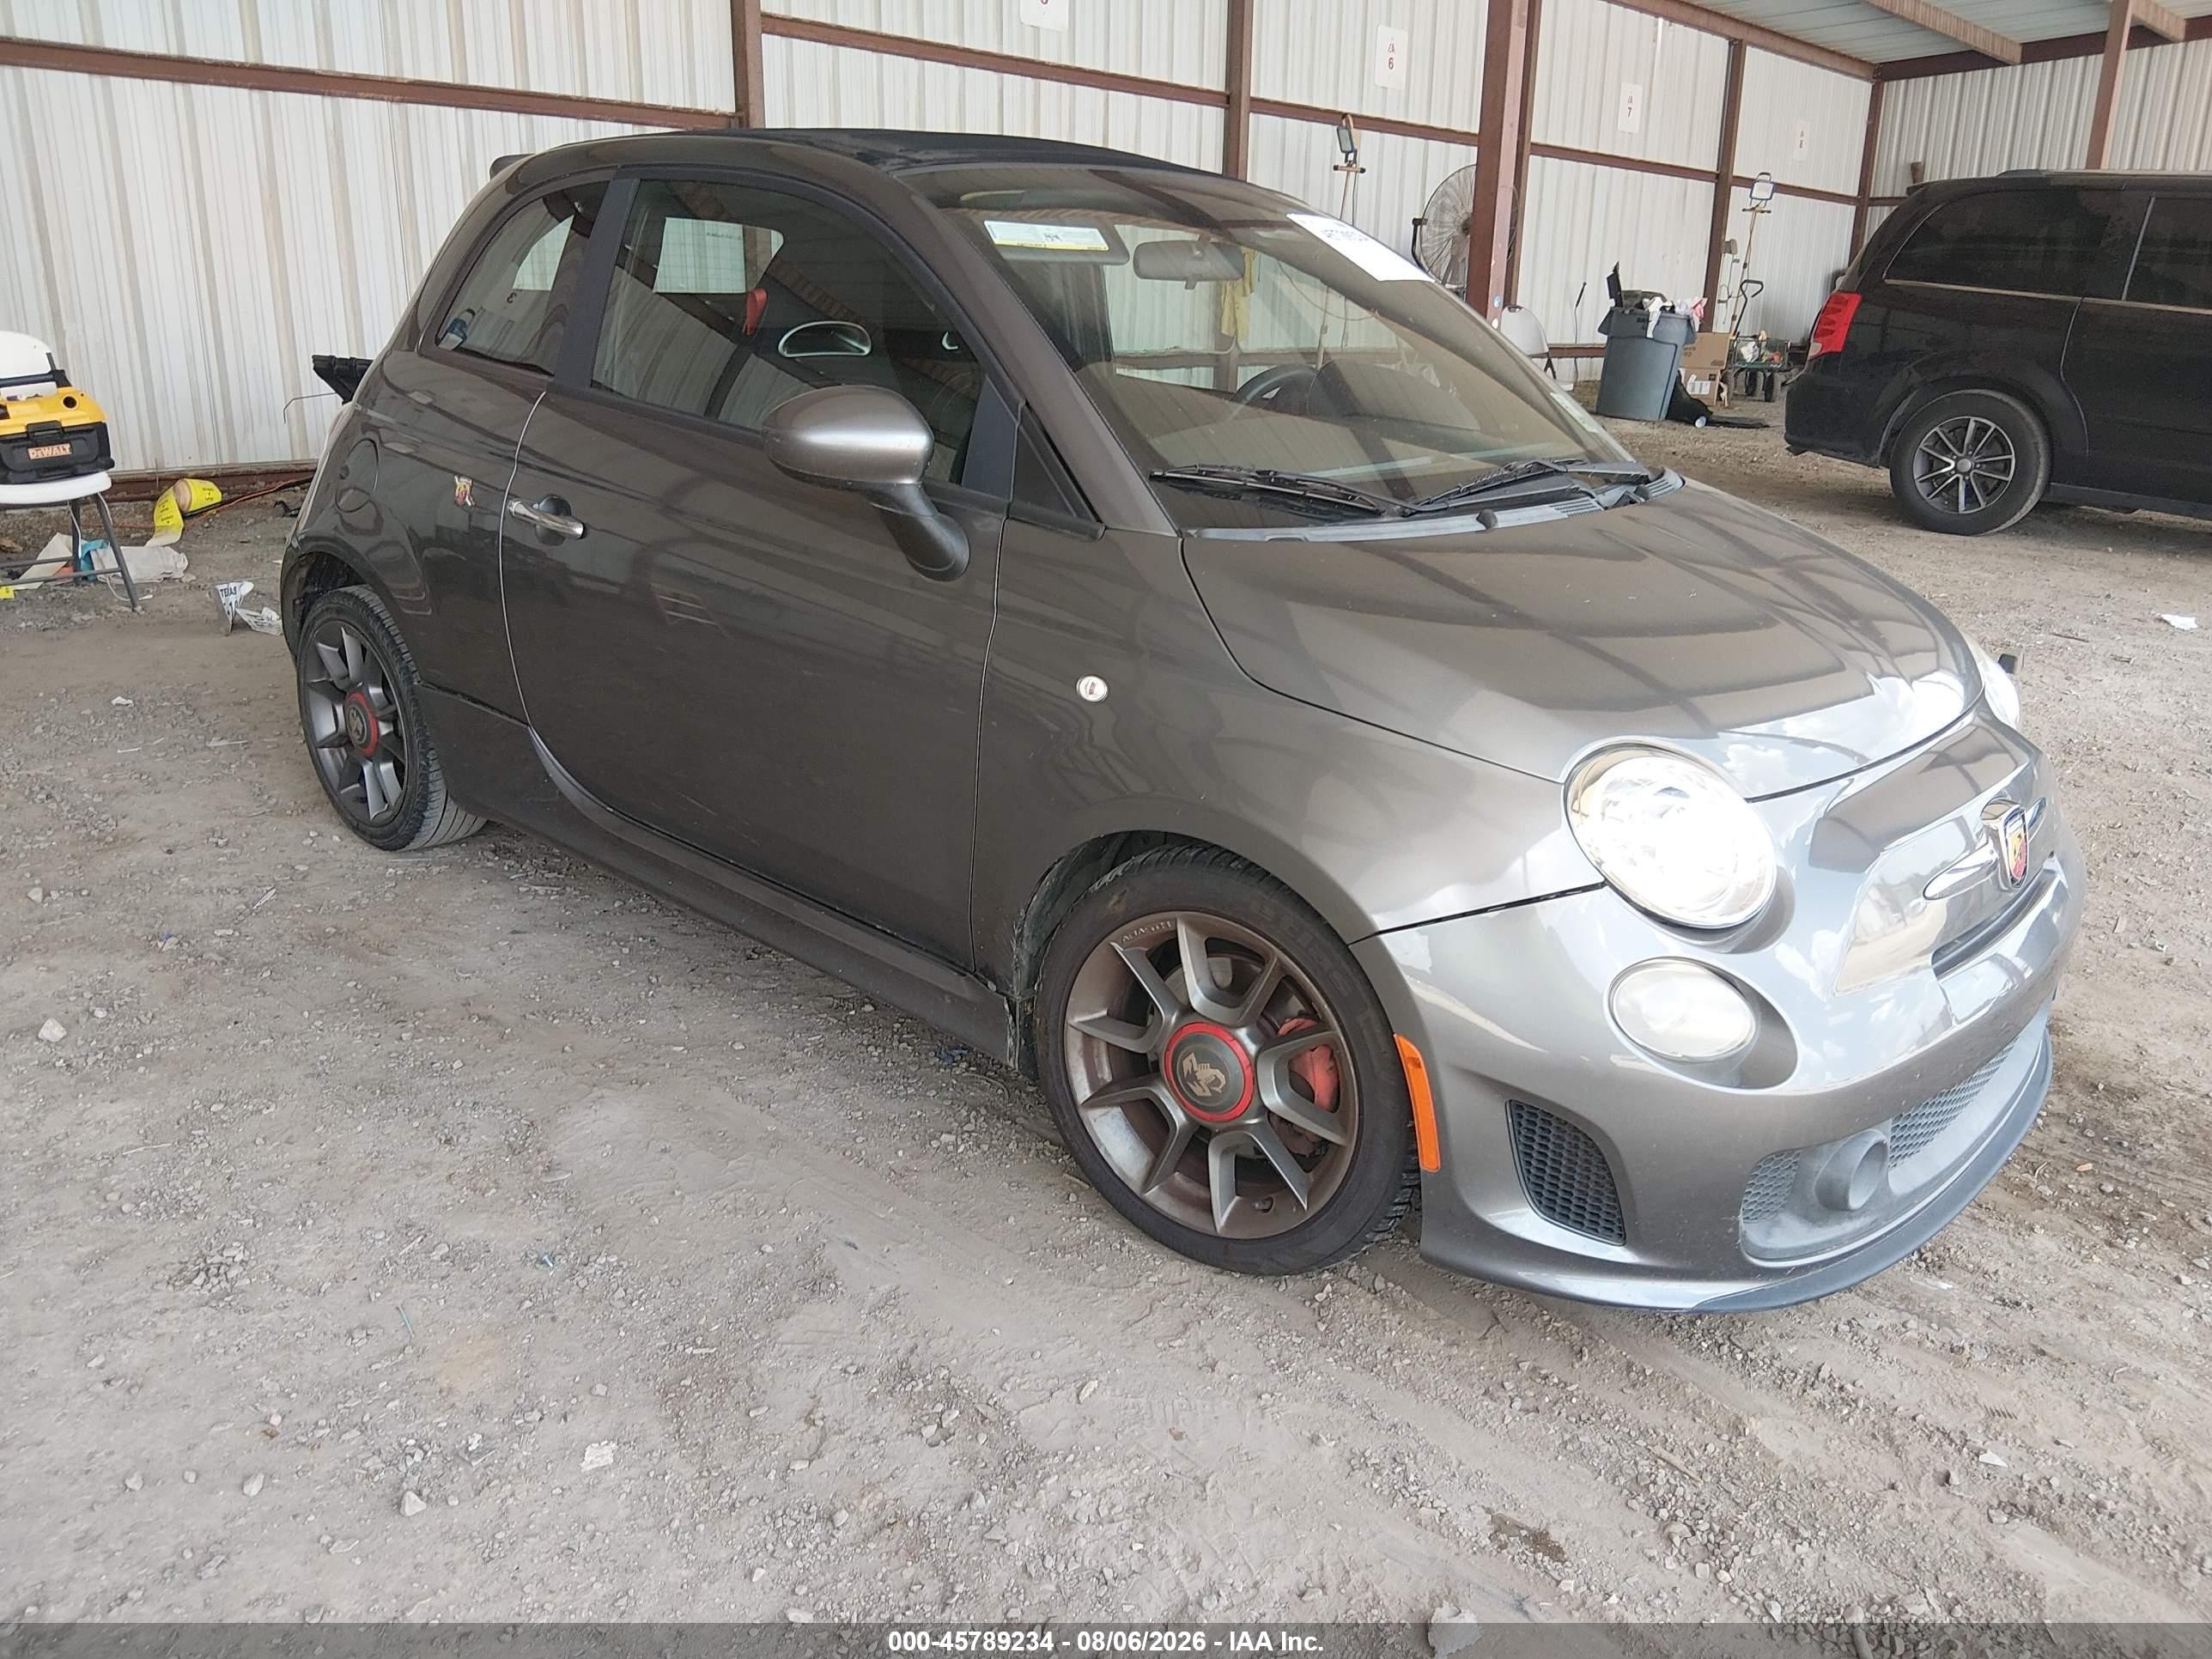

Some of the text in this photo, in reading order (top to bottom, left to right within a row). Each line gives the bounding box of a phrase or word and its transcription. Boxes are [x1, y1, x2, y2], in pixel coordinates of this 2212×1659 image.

[1388, 57, 1395, 70] 6
[1627, 106, 1632, 118] 7
[30, 445, 70, 459] DEWALT
